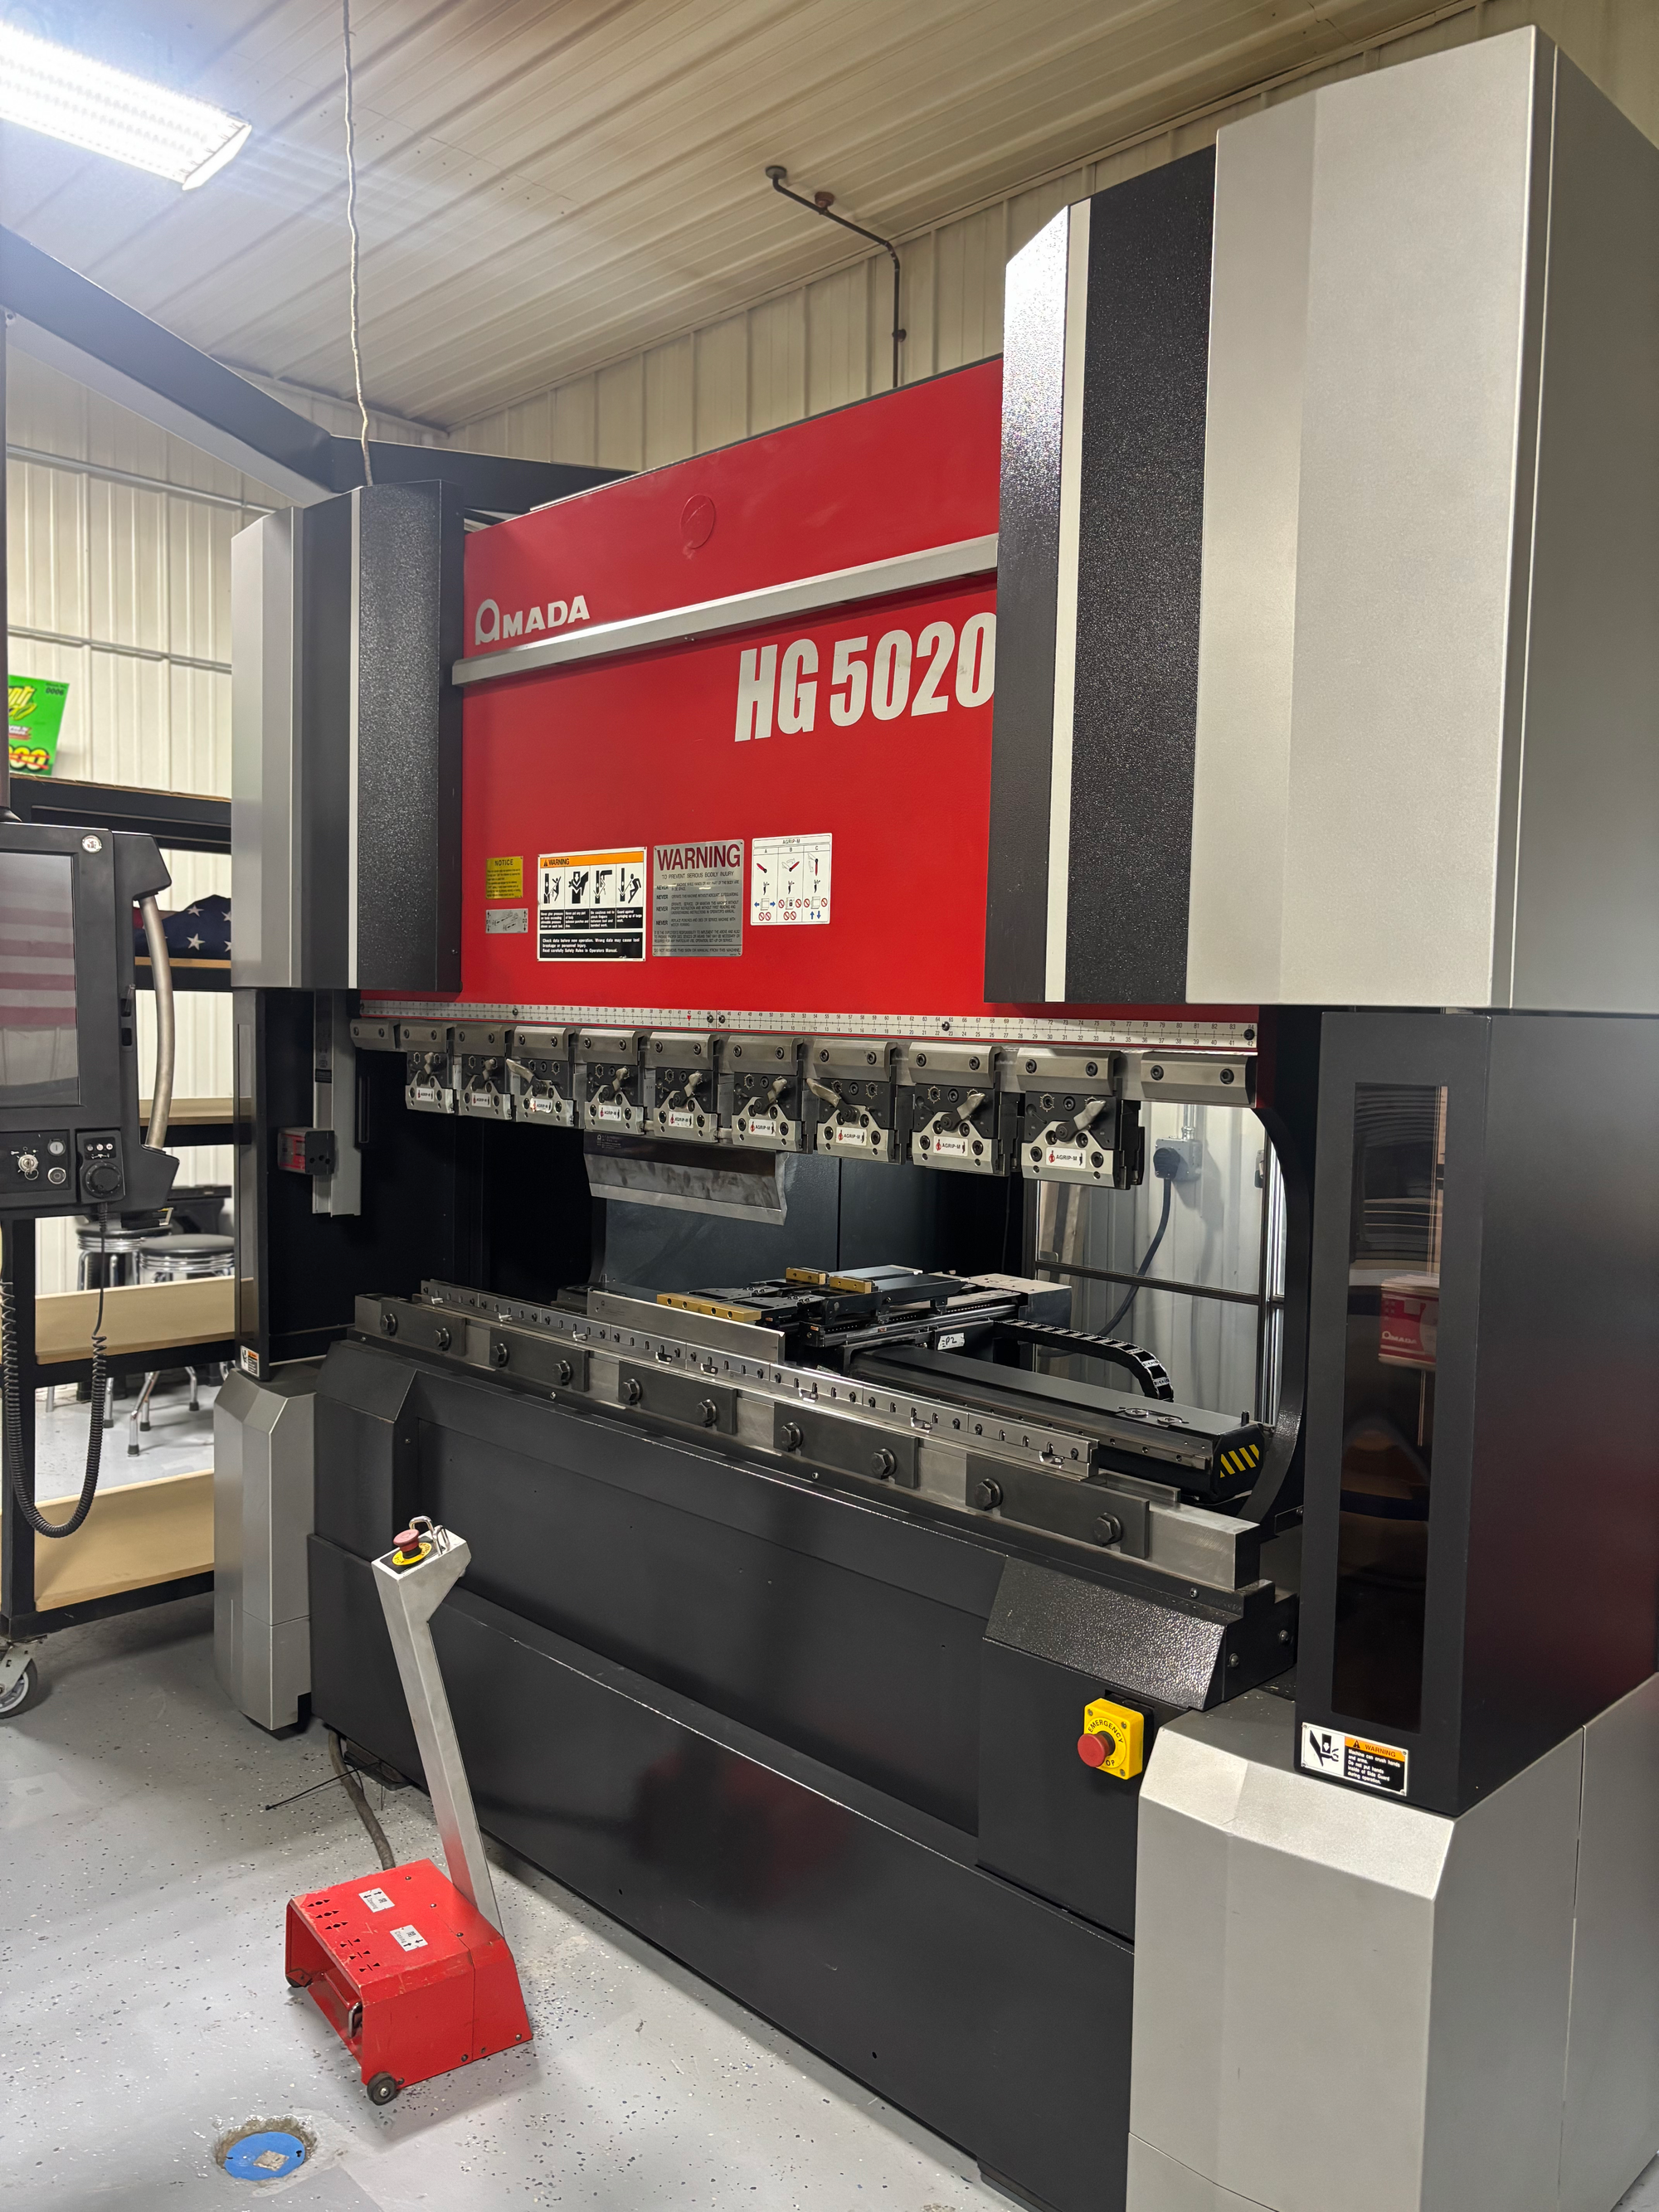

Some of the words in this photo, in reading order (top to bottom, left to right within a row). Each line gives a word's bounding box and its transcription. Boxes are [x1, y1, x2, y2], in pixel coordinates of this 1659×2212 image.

[735, 638, 819, 742] HG
[829, 613, 997, 726] 5020
[46, 687, 64, 695] 0006
[657, 844, 740, 871] WARNING
[1088, 1719, 1123, 1744] EMERGENCY
[1348, 1749, 1365, 1759] Machine
[1365, 1744, 1396, 1757] WARNING
[1378, 1773, 1390, 1781] Guard
